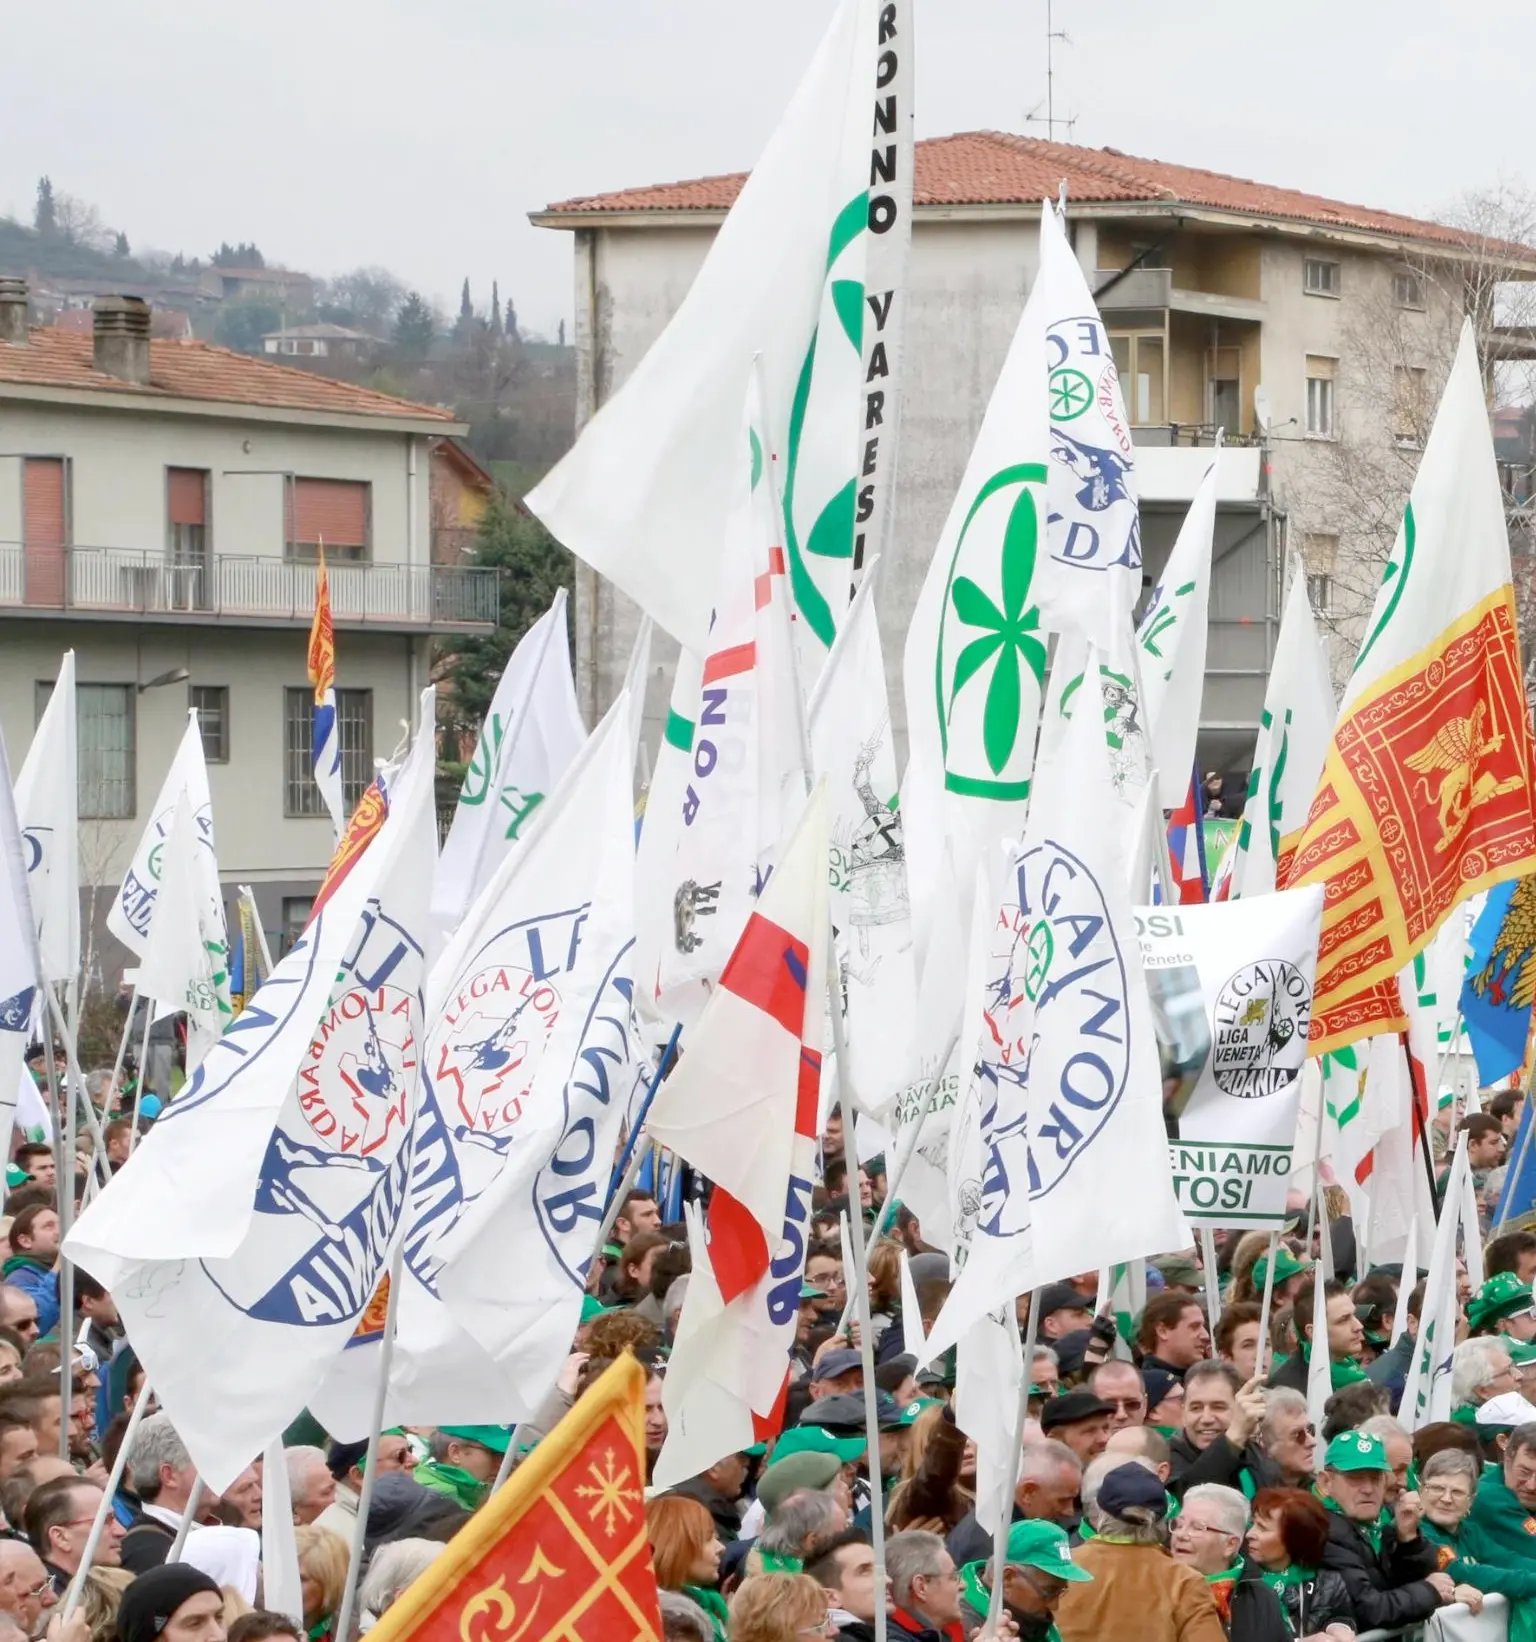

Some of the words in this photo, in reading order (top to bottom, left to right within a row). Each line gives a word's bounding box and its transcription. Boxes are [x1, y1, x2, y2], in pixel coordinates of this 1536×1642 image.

[849, 290, 894, 596] VARESI
[445, 969, 512, 1025] LEGA
[1218, 965, 1270, 1025] LEGA
[1276, 964, 1310, 1040] NORD
[1216, 1046, 1262, 1064] VENETA
[1218, 1028, 1248, 1045] LIGA
[1028, 988, 1122, 1190] NOR
[1217, 1068, 1291, 1098] PADANIA
[545, 1045, 623, 1280] NOR
[1169, 1150, 1291, 1176] NIAMO
[1173, 1176, 1254, 1209] TOSI
